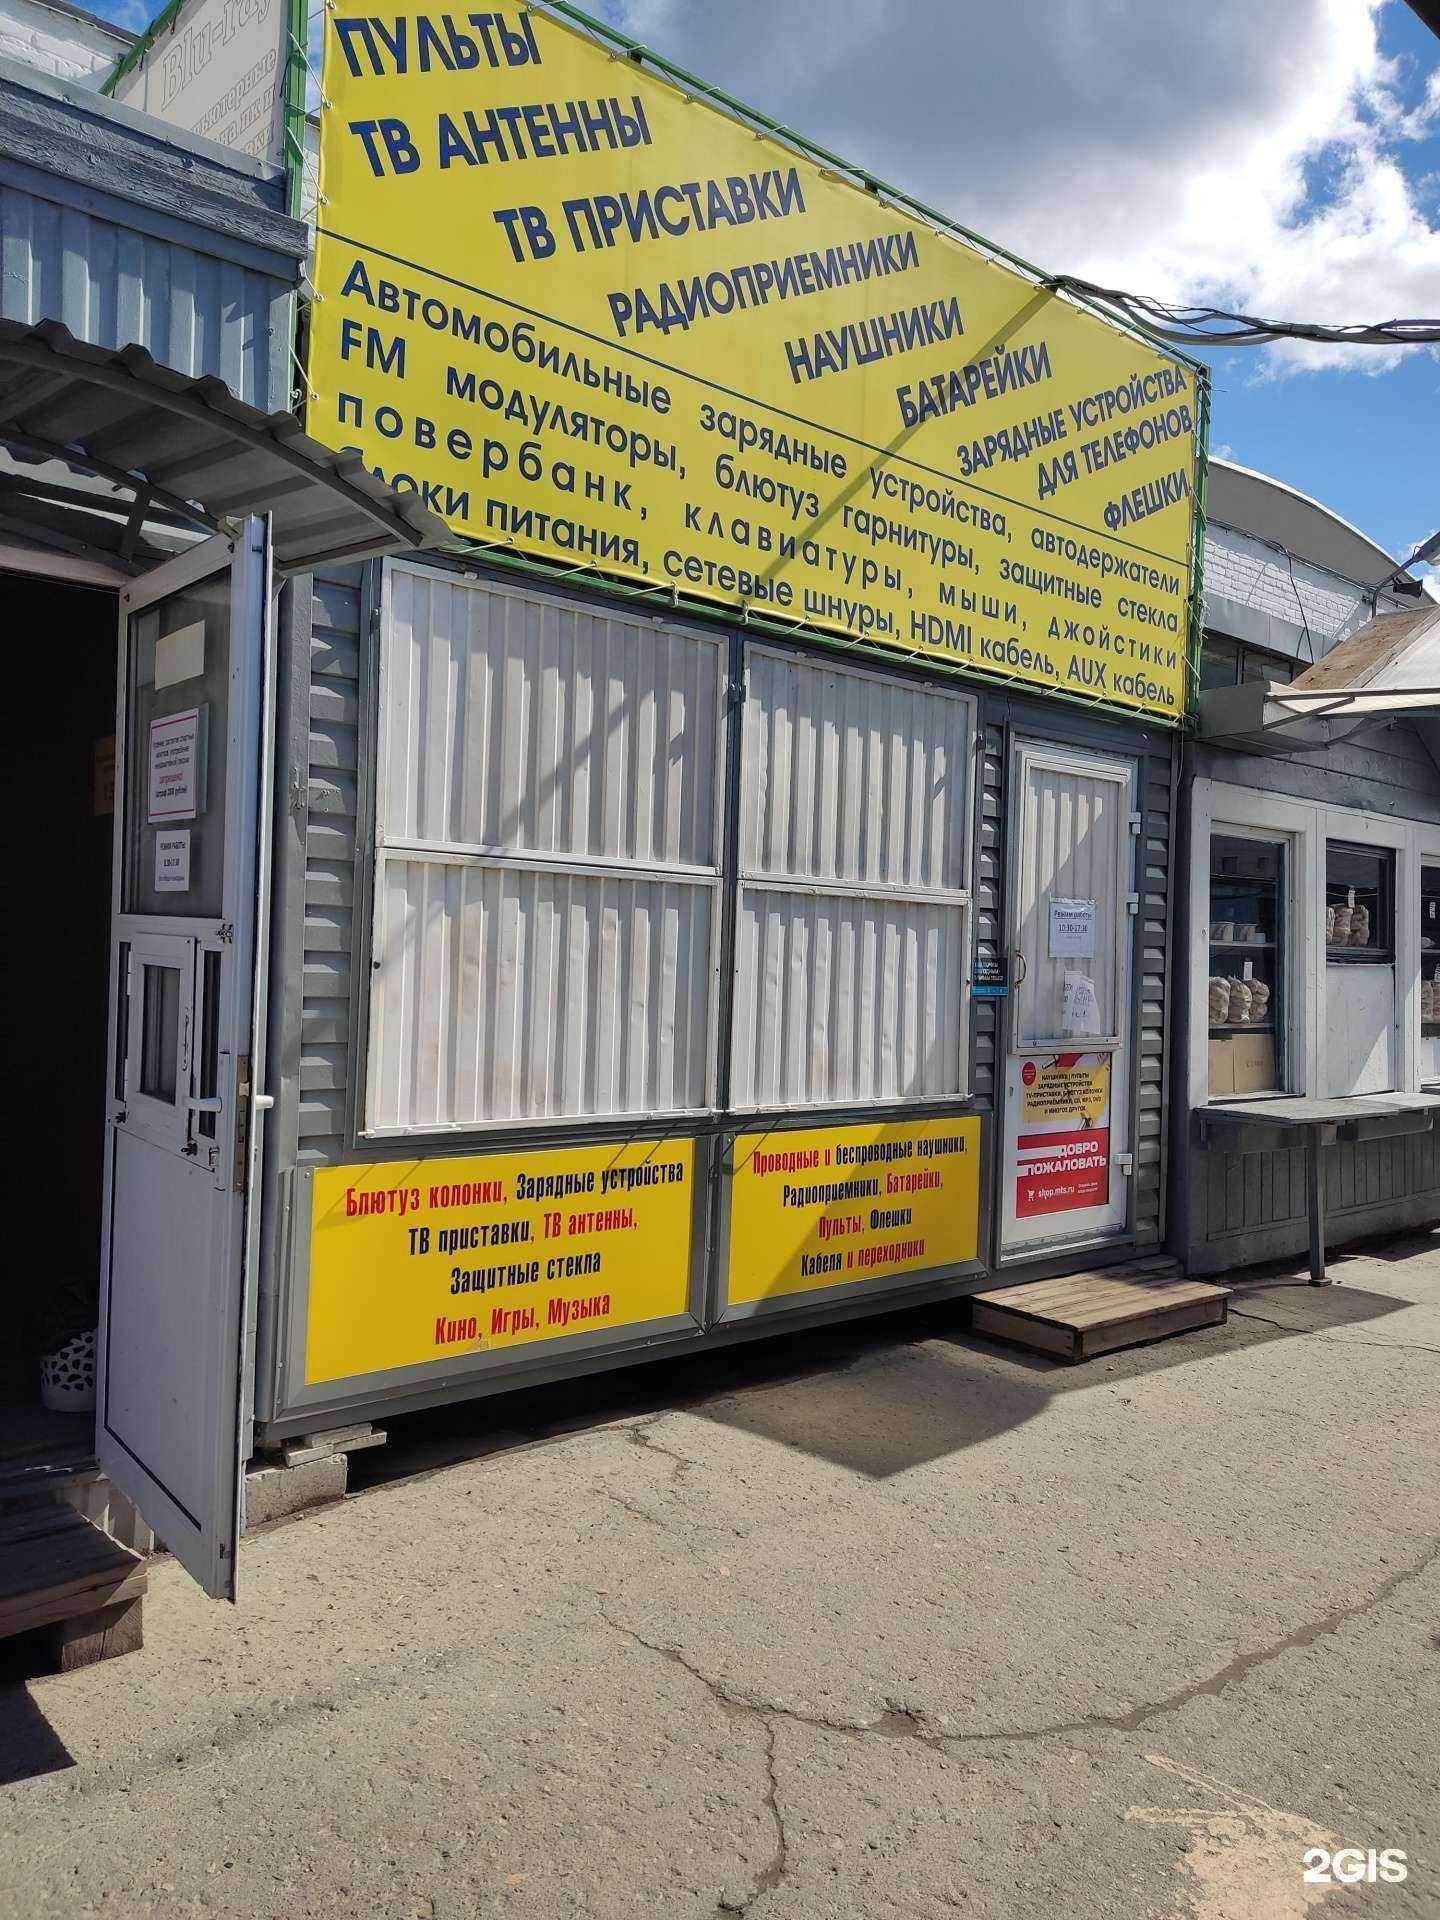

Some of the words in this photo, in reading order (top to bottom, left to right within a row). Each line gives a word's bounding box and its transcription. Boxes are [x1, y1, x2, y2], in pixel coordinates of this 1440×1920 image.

[333, 12, 542, 77] ПУЛЬТЫ
[348, 118, 421, 178] ТВ
[438, 95, 653, 170] АНТЕННЫ
[493, 206, 556, 263] ТВ
[562, 168, 806, 253] ПРИСТАВКИ
[607, 231, 920, 337] РАДИОПРИЕМНИКИ
[784, 297, 964, 385] НАУШНИКИ
[896, 341, 1053, 428] БАТАРЕЙКИ
[340, 259, 672, 415] Автомобильные
[700, 404, 847, 479] зарядные
[869, 466, 1012, 543] устройства,
[1031, 527, 1179, 596] автодержатели
[956, 408, 1067, 477] ЗАРЯДНЫЕ
[1068, 365, 1187, 432] УСТРОЙСТВА
[1037, 449, 1080, 499] ДЛЯ
[1080, 405, 1193, 475] ТЕЛЕФОНОВ
[341, 318, 406, 379] FM
[446, 366, 686, 480] модуляторы,
[716, 454, 819, 521] блютуз
[843, 504, 979, 575] гарнитуры,
[1000, 558, 1102, 608] защитные
[1118, 597, 1178, 632] стекла
[1103, 468, 1190, 531] ФЛЕШКИ
[338, 393, 647, 521] повербанк,
[685, 503, 913, 598] клавиатуры,
[939, 582, 1027, 632] мыши,
[1048, 616, 1176, 669] джойстики
[486, 498, 649, 576] питания,
[664, 550, 793, 606] сетевые
[804, 588, 900, 639] шнуры,
[911, 610, 972, 654] HDMI
[980, 636, 1060, 681] кабель,
[1067, 655, 1107, 688] AUX
[1113, 672, 1175, 706] кабель
[753, 1148, 820, 1177] Проводные
[824, 1150, 831, 1164] и
[836, 1140, 913, 1167] беспроводные
[917, 1135, 968, 1158] наушники,
[1026, 1156, 1107, 1176] ПОЖАЛОВАТЬ
[1058, 1141, 1098, 1158] ДОБРО
[345, 1186, 420, 1217] Блютуз
[429, 1179, 508, 1208] колонки,
[516, 1168, 595, 1201] Зарядные
[601, 1160, 683, 1195] устройства
[783, 1180, 882, 1208] Радиоприемники,
[886, 1169, 944, 1194] Батарейки,
[408, 1226, 429, 1256] ТВ
[438, 1219, 535, 1256] приставки,
[543, 1211, 561, 1239] ТВ
[568, 1207, 638, 1233] антенны,
[818, 1216, 865, 1241] Пульты,
[870, 1207, 912, 1230] Флешки
[450, 1260, 539, 1295] Защитные
[547, 1252, 601, 1281] стекла
[801, 1252, 842, 1277] Кабеля
[847, 1254, 854, 1269] и
[858, 1238, 925, 1266] переходники
[435, 1315, 482, 1345] Кино,
[490, 1307, 540, 1337] Игры,
[547, 1293, 610, 1326] Музыка
